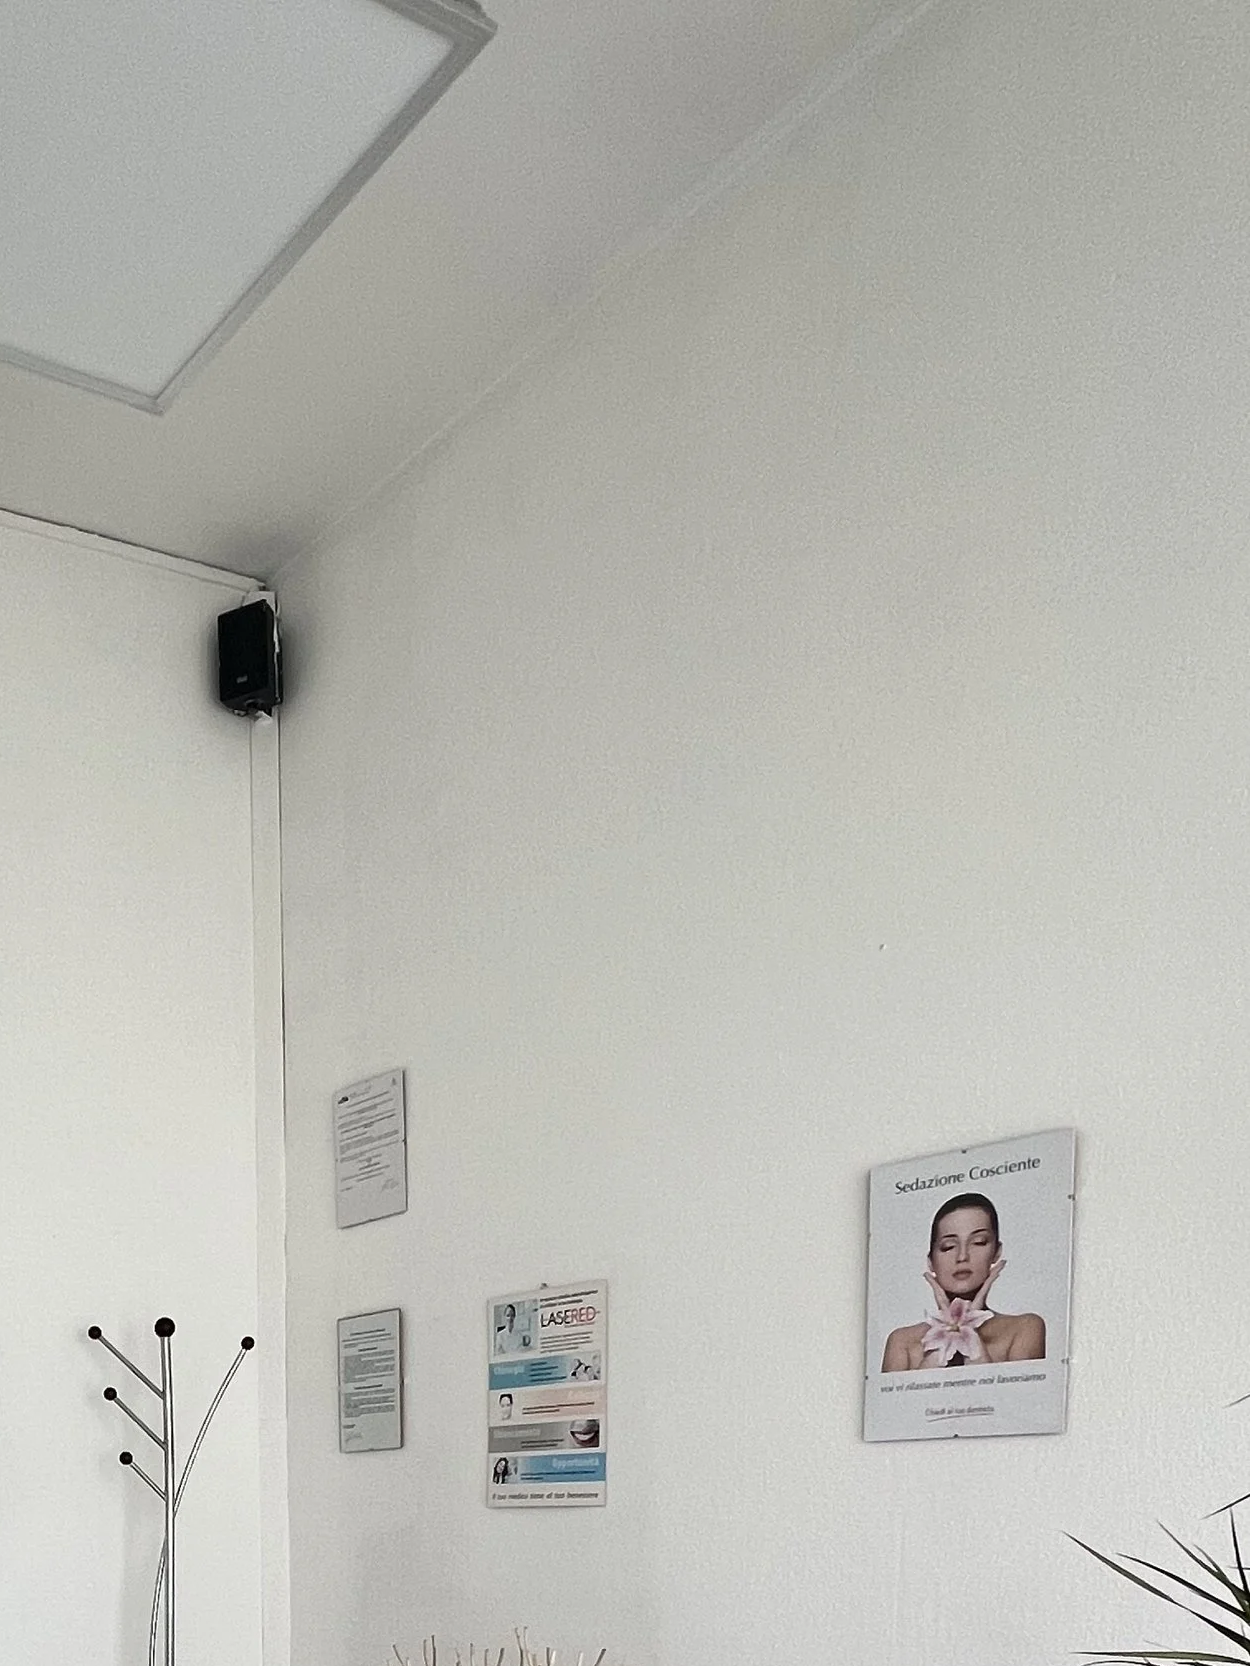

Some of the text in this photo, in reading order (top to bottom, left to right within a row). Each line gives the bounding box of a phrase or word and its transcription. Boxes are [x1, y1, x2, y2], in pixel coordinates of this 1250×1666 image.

[894, 1156, 1041, 1195] Sedazione Cosciente
[540, 1305, 597, 1328] LASERED
